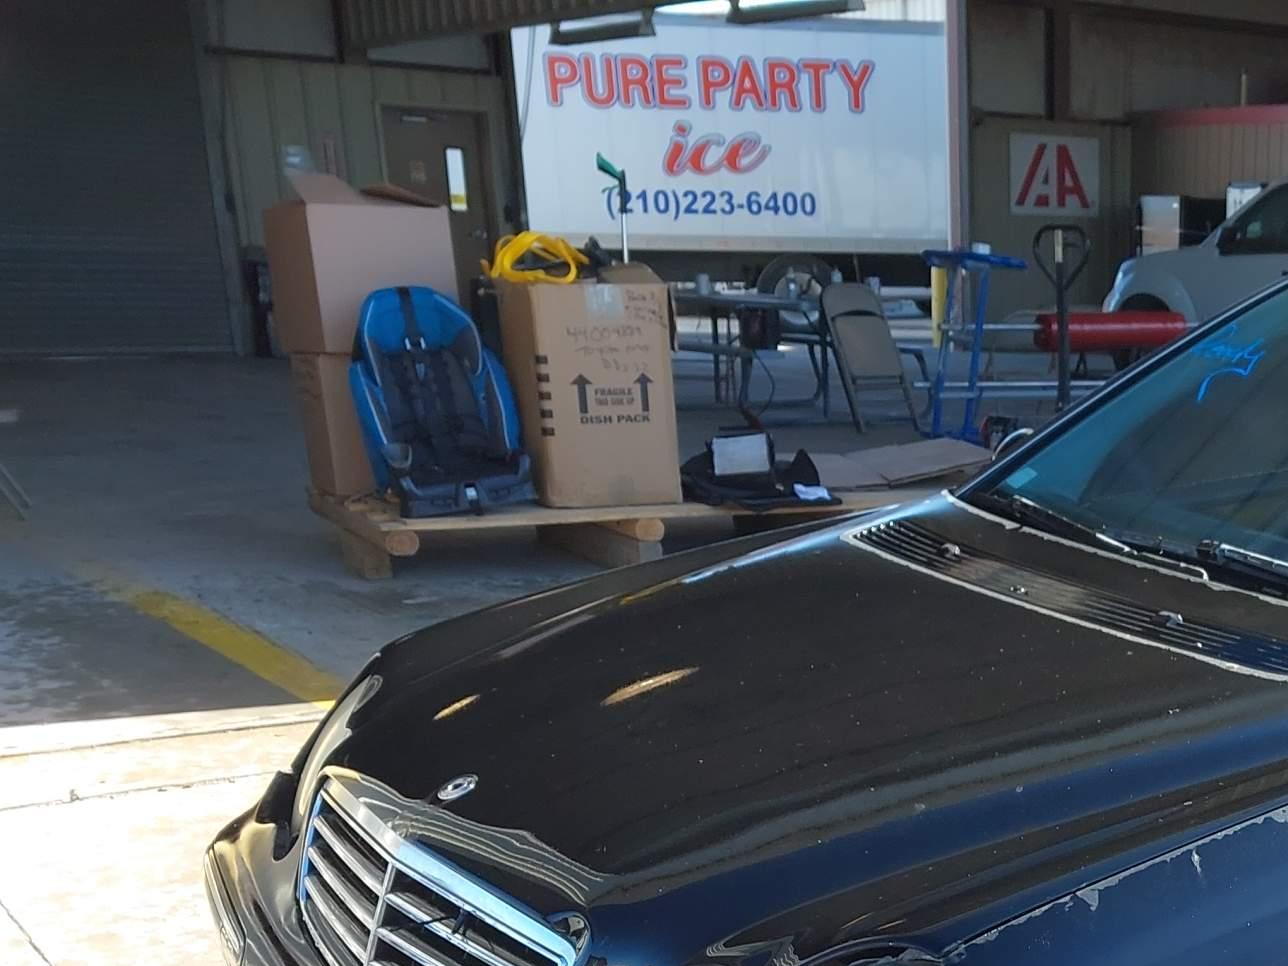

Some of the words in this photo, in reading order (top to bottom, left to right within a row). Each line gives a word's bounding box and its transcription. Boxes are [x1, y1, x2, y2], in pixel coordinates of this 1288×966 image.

[543, 52, 691, 109] PURE
[696, 55, 875, 113] PARTY
[663, 119, 772, 177] ice
[606, 189, 816, 221] (210)223-6400
[580, 415, 612, 424] DISH
[617, 414, 650, 423] PACK
